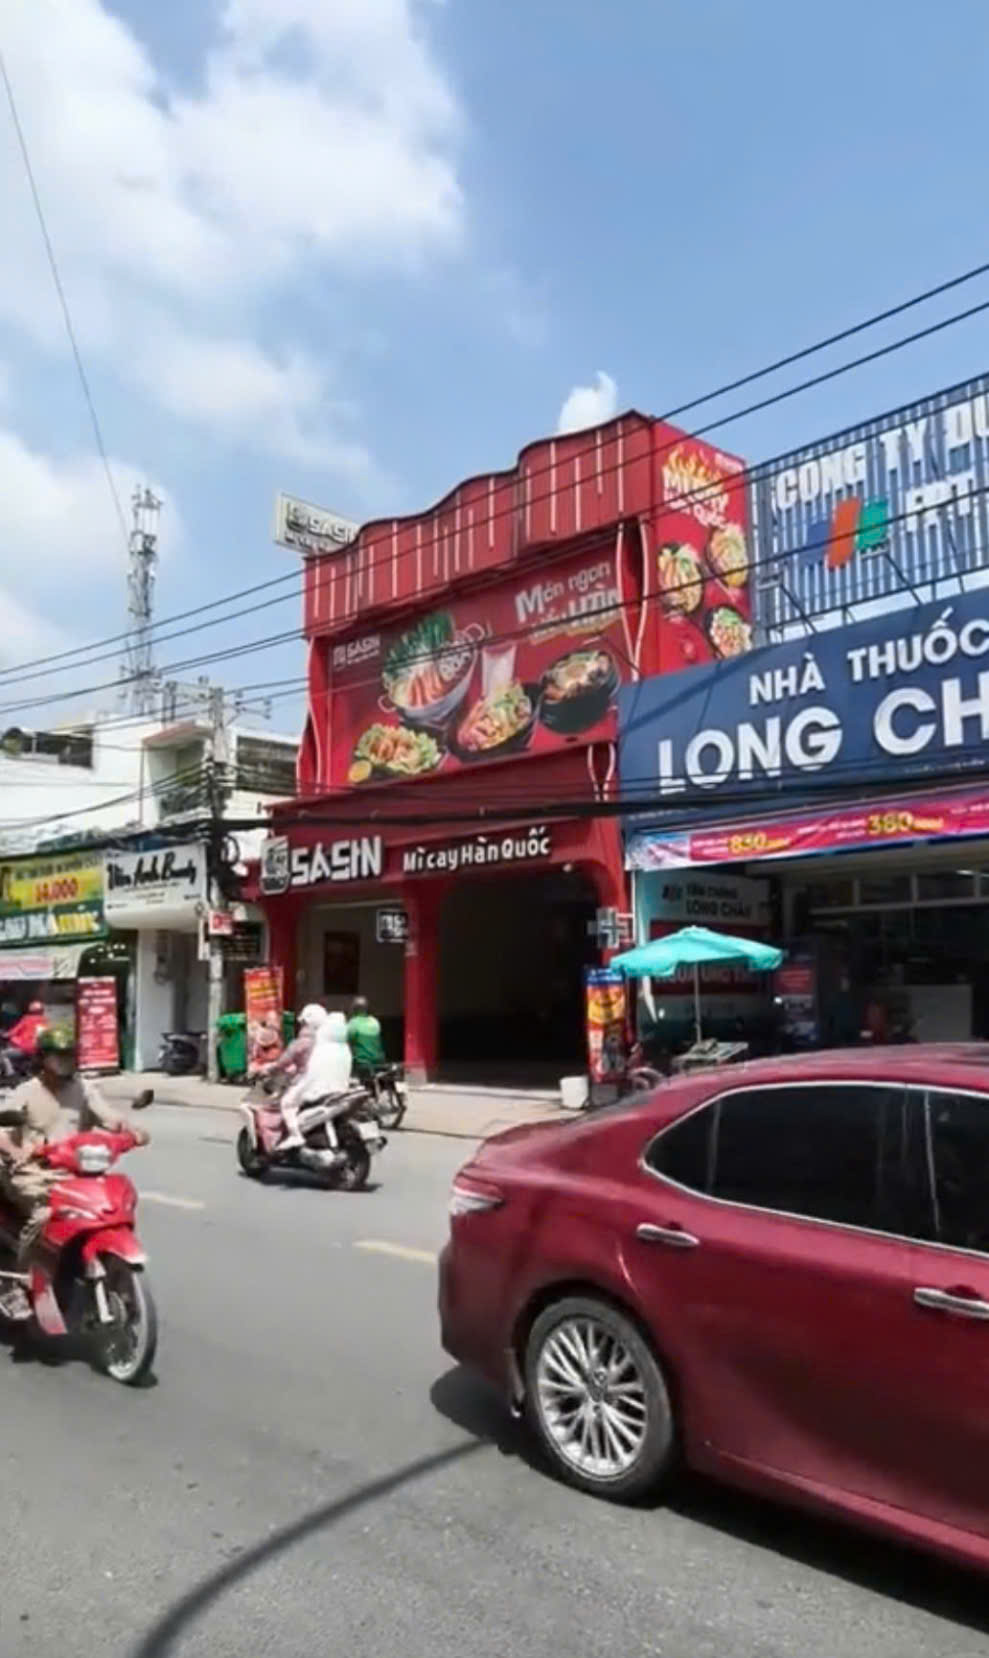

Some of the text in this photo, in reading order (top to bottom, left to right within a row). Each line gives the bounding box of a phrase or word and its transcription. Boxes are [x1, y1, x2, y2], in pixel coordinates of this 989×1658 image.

[879, 417, 928, 473] TY
[750, 607, 989, 705] NHÀ THUỐC
[658, 706, 843, 795] LONG
[291, 836, 382, 886] SASIN
[403, 826, 551, 872] Mì cay Hàn Quốc
